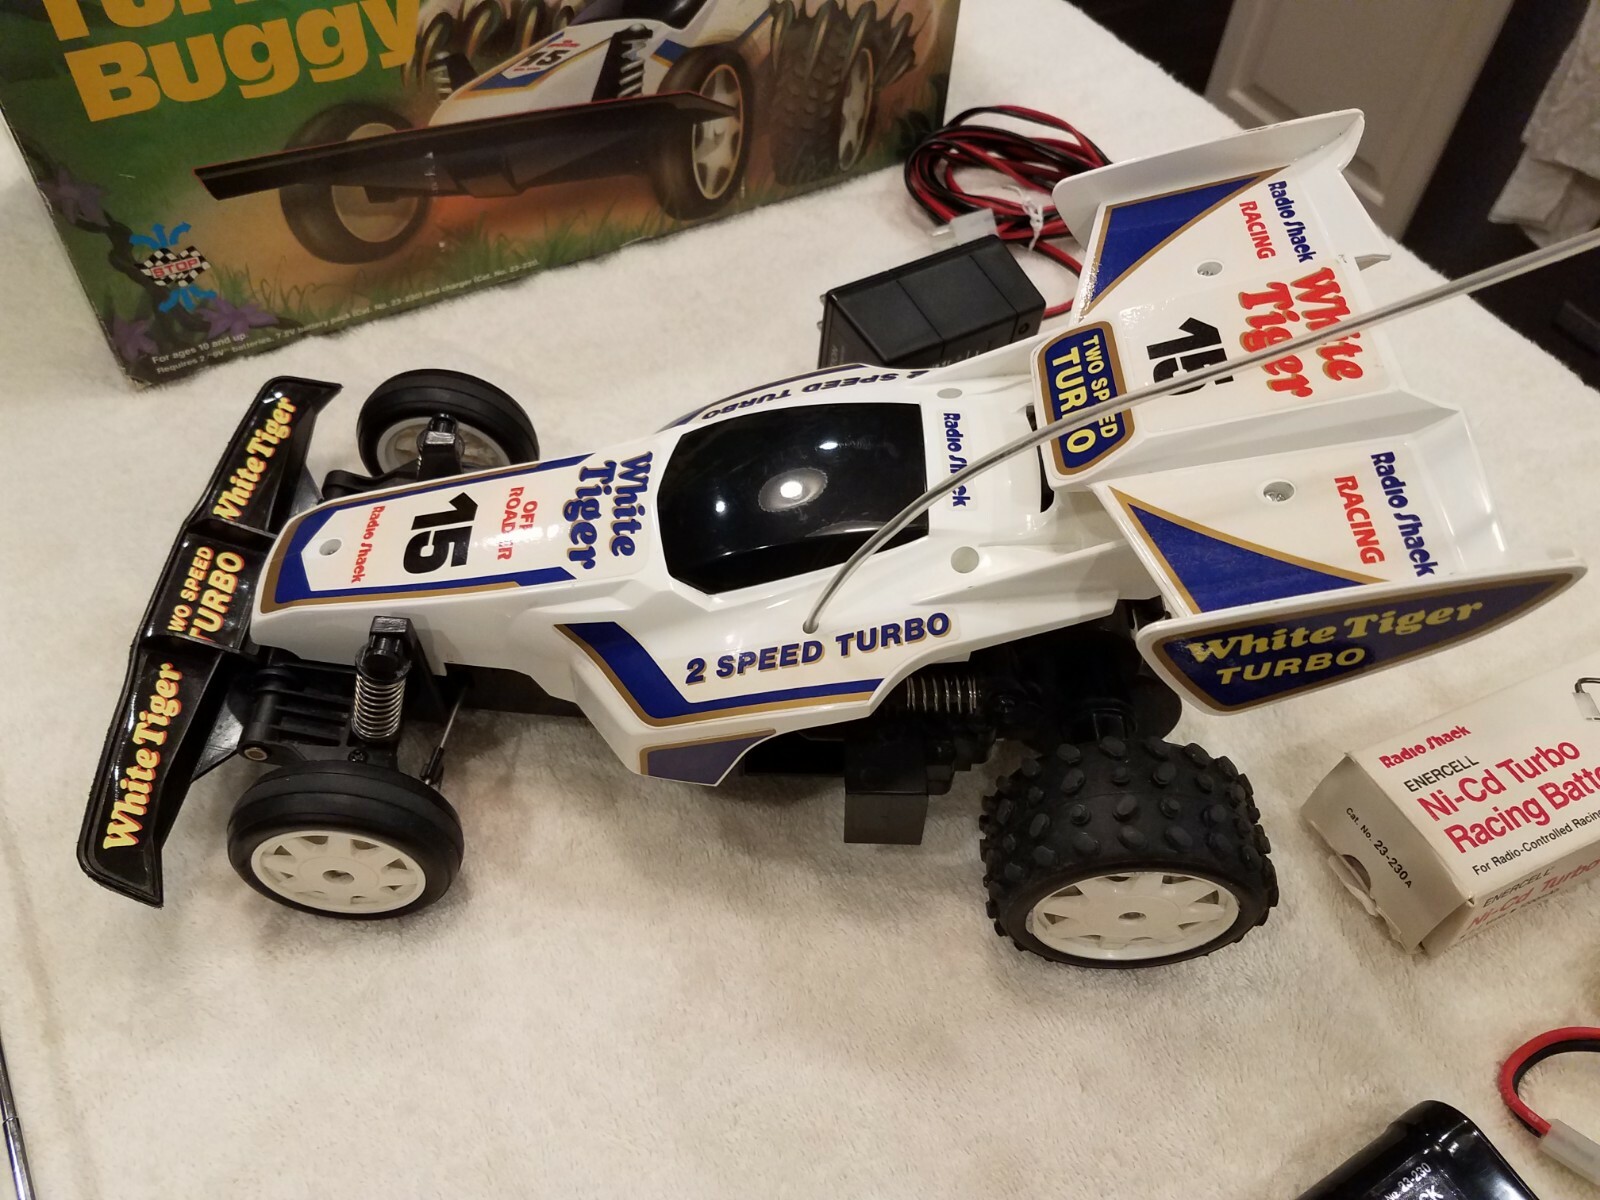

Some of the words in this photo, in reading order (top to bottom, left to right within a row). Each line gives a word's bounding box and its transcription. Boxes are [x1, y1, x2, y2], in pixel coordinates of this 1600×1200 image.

[64, 0, 419, 122] Buggy
[1239, 200, 1276, 260] RACING
[1268, 180, 1296, 219] Radio
[1283, 221, 1317, 263] Shack
[152, 258, 199, 278] STOP
[151, 353, 170, 364] For
[172, 347, 198, 359] ages
[198, 342, 210, 352] 10
[211, 336, 232, 349] and
[1290, 266, 1364, 381] Whte
[156, 358, 199, 374] Requires
[801, 372, 900, 393] SPEED
[1082, 334, 1105, 374] TWO
[701, 388, 792, 420] TURBO
[1052, 346, 1096, 454] TURO
[1091, 377, 1118, 438] SPED
[213, 456, 267, 521] White
[247, 396, 298, 459] Tiger
[943, 412, 964, 452] Radio
[609, 450, 654, 557] White
[948, 454, 971, 507] Shck
[363, 505, 386, 540] Radio
[403, 491, 479, 575] 15
[563, 459, 618, 571] Tiger
[1334, 475, 1386, 565] RACING
[1370, 451, 1408, 509] Radio
[1393, 512, 1438, 577] Shack
[167, 604, 193, 632] WO
[180, 546, 215, 602] SPEED
[351, 542, 373, 584] Shack
[685, 657, 707, 685] 2
[716, 640, 825, 679] SPEED
[835, 612, 952, 658] TURBO
[1185, 624, 1338, 664] White
[1344, 601, 1484, 639] Tiger
[1216, 648, 1367, 685] TURBO
[102, 747, 161, 850] White
[132, 661, 183, 746] Tiger
[1378, 744, 1427, 769] Radio
[1426, 725, 1472, 751] Shack
[1403, 755, 1480, 793] ENERCELL
[1416, 768, 1507, 822] Ni-Cd
[1494, 741, 1581, 784] Turbo
[1346, 807, 1359, 826] Cat.
[1360, 825, 1372, 842] No.
[1443, 797, 1551, 854] Racing
[1472, 862, 1491, 876] For
[1490, 822, 1574, 868] Radio-Controlled
[1571, 809, 1600, 829] Racin
[1467, 887, 1535, 931] Ni-Cd
[1541, 859, 1600, 892] Turbo
[1483, 867, 1553, 908] ENERCELL
[1398, 1162, 1432, 1193] 23-230
